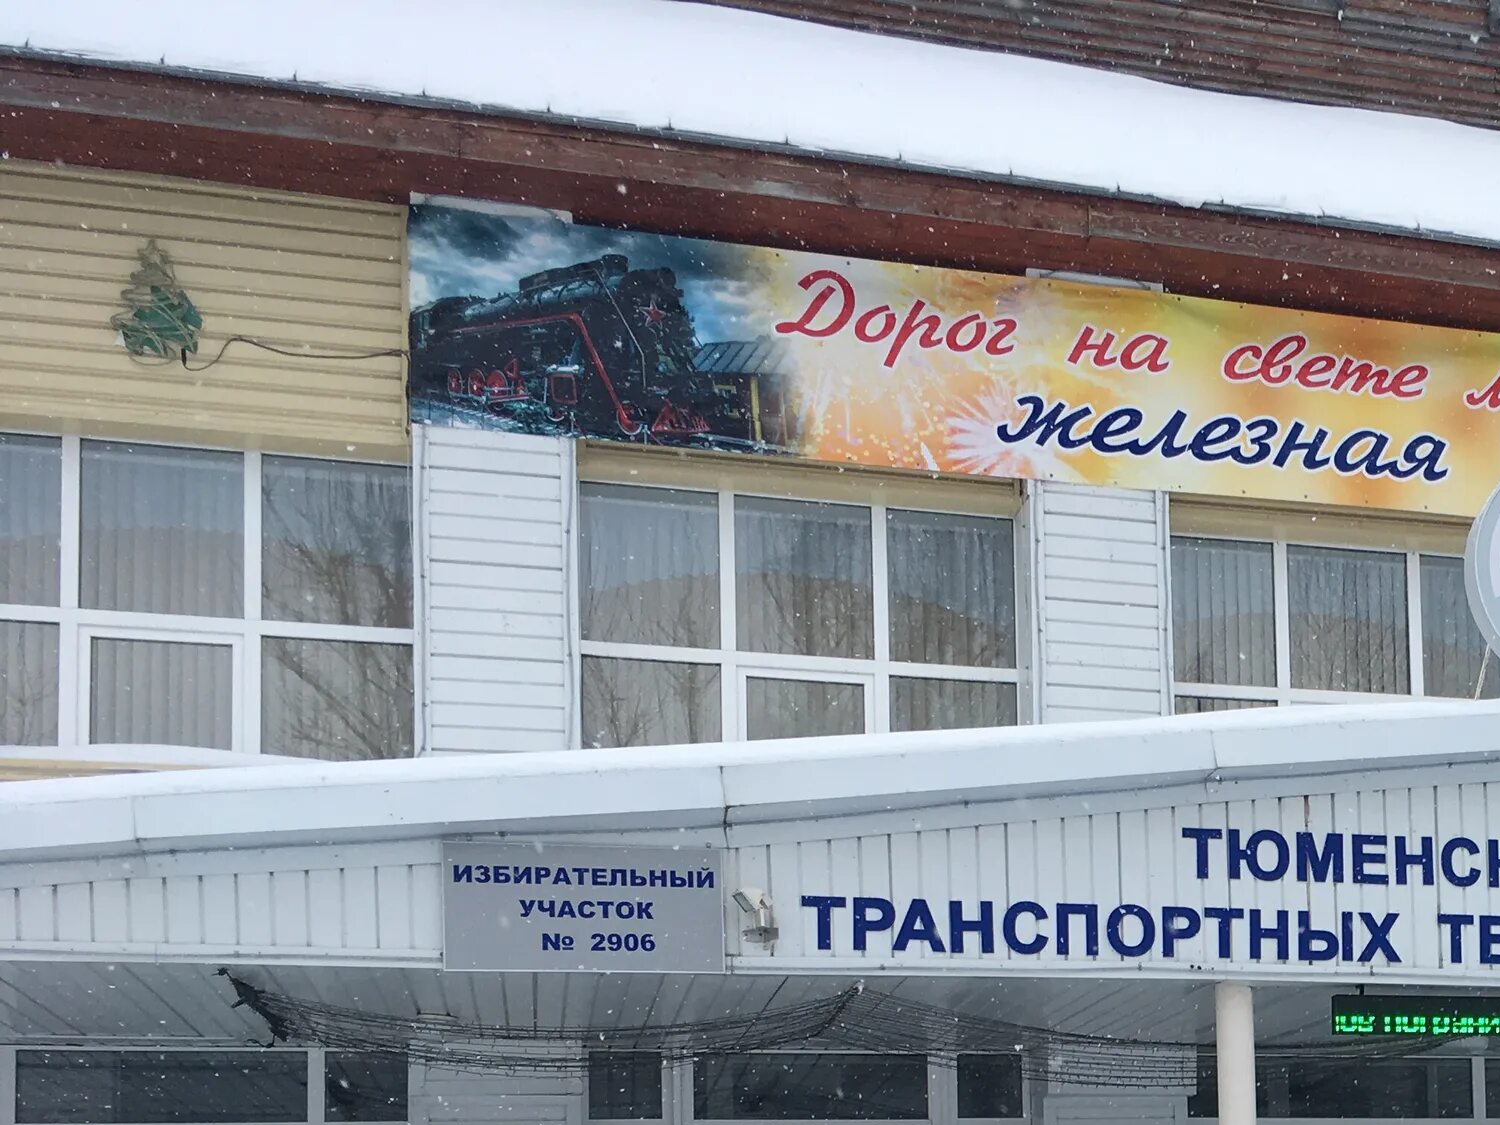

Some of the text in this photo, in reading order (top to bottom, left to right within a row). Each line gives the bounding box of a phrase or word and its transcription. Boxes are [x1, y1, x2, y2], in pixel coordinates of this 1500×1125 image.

[776, 270, 1015, 367] Дорог
[1069, 325, 1168, 371] на
[1223, 335, 1427, 398] свете
[996, 396, 1449, 481] железная
[453, 864, 715, 889] ИЗБИРАТЕЛЬНЫЙ
[519, 899, 655, 920] УЧАСТОК
[800, 895, 1401, 963] ТРАНСПОРТНЫХ
[541, 932, 656, 952] № 2906
